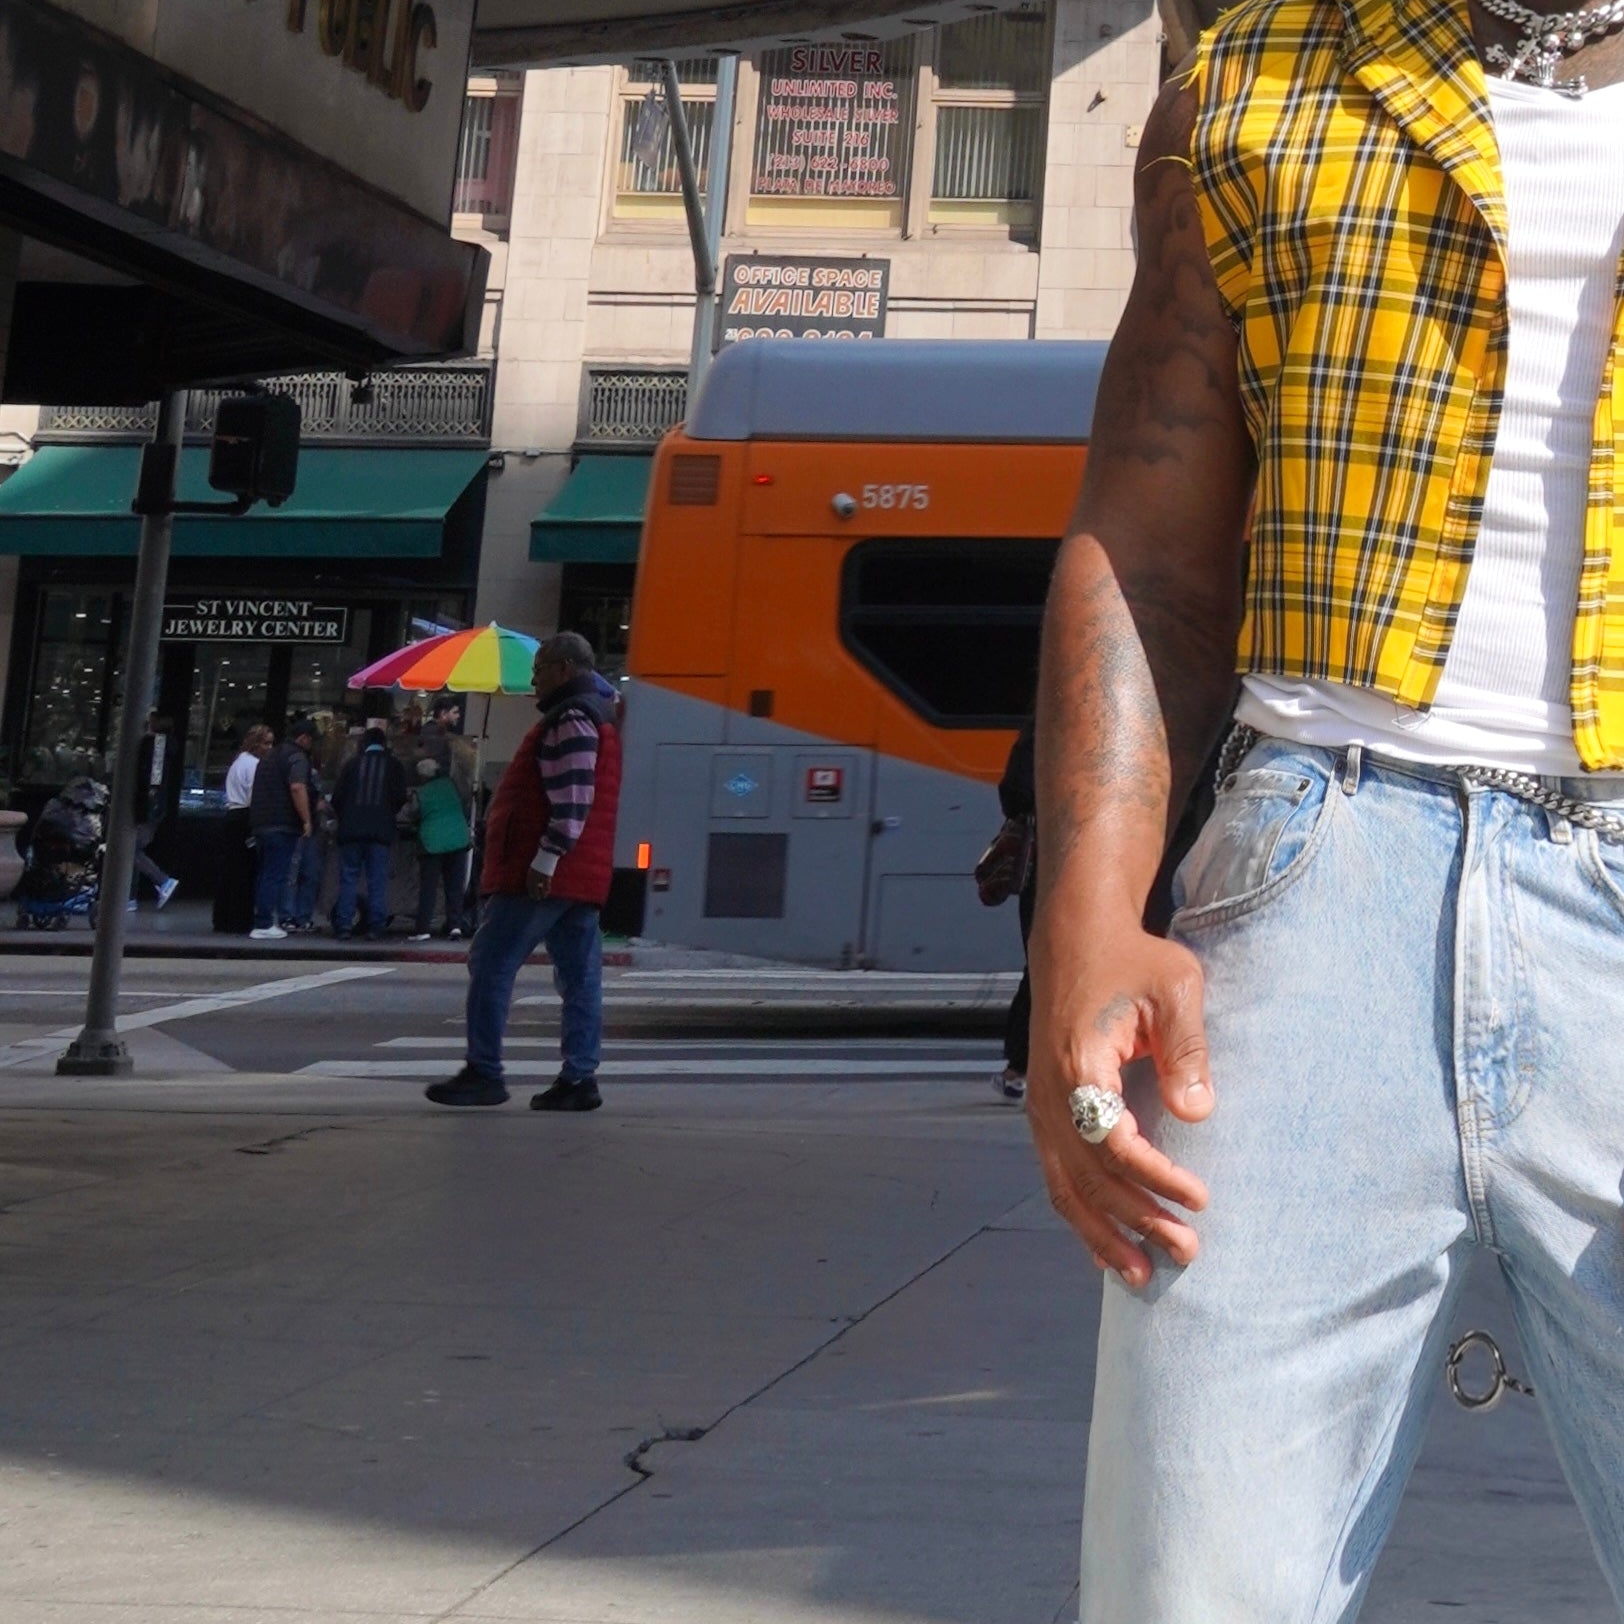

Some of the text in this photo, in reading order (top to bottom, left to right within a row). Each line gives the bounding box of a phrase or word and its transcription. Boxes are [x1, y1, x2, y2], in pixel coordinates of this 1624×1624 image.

[791, 48, 882, 74] SILVER
[771, 78, 898, 99] UNLIMITED INC.
[767, 104, 899, 124] WHOLESALE SILVER
[791, 129, 870, 148] SUITE 216
[733, 264, 883, 288] OFFICE SPACE
[727, 287, 881, 319] AVAILABLE
[862, 484, 930, 510] 5875
[196, 600, 312, 616] ST VINCENT
[165, 619, 339, 637] JEWELRY CENTER
